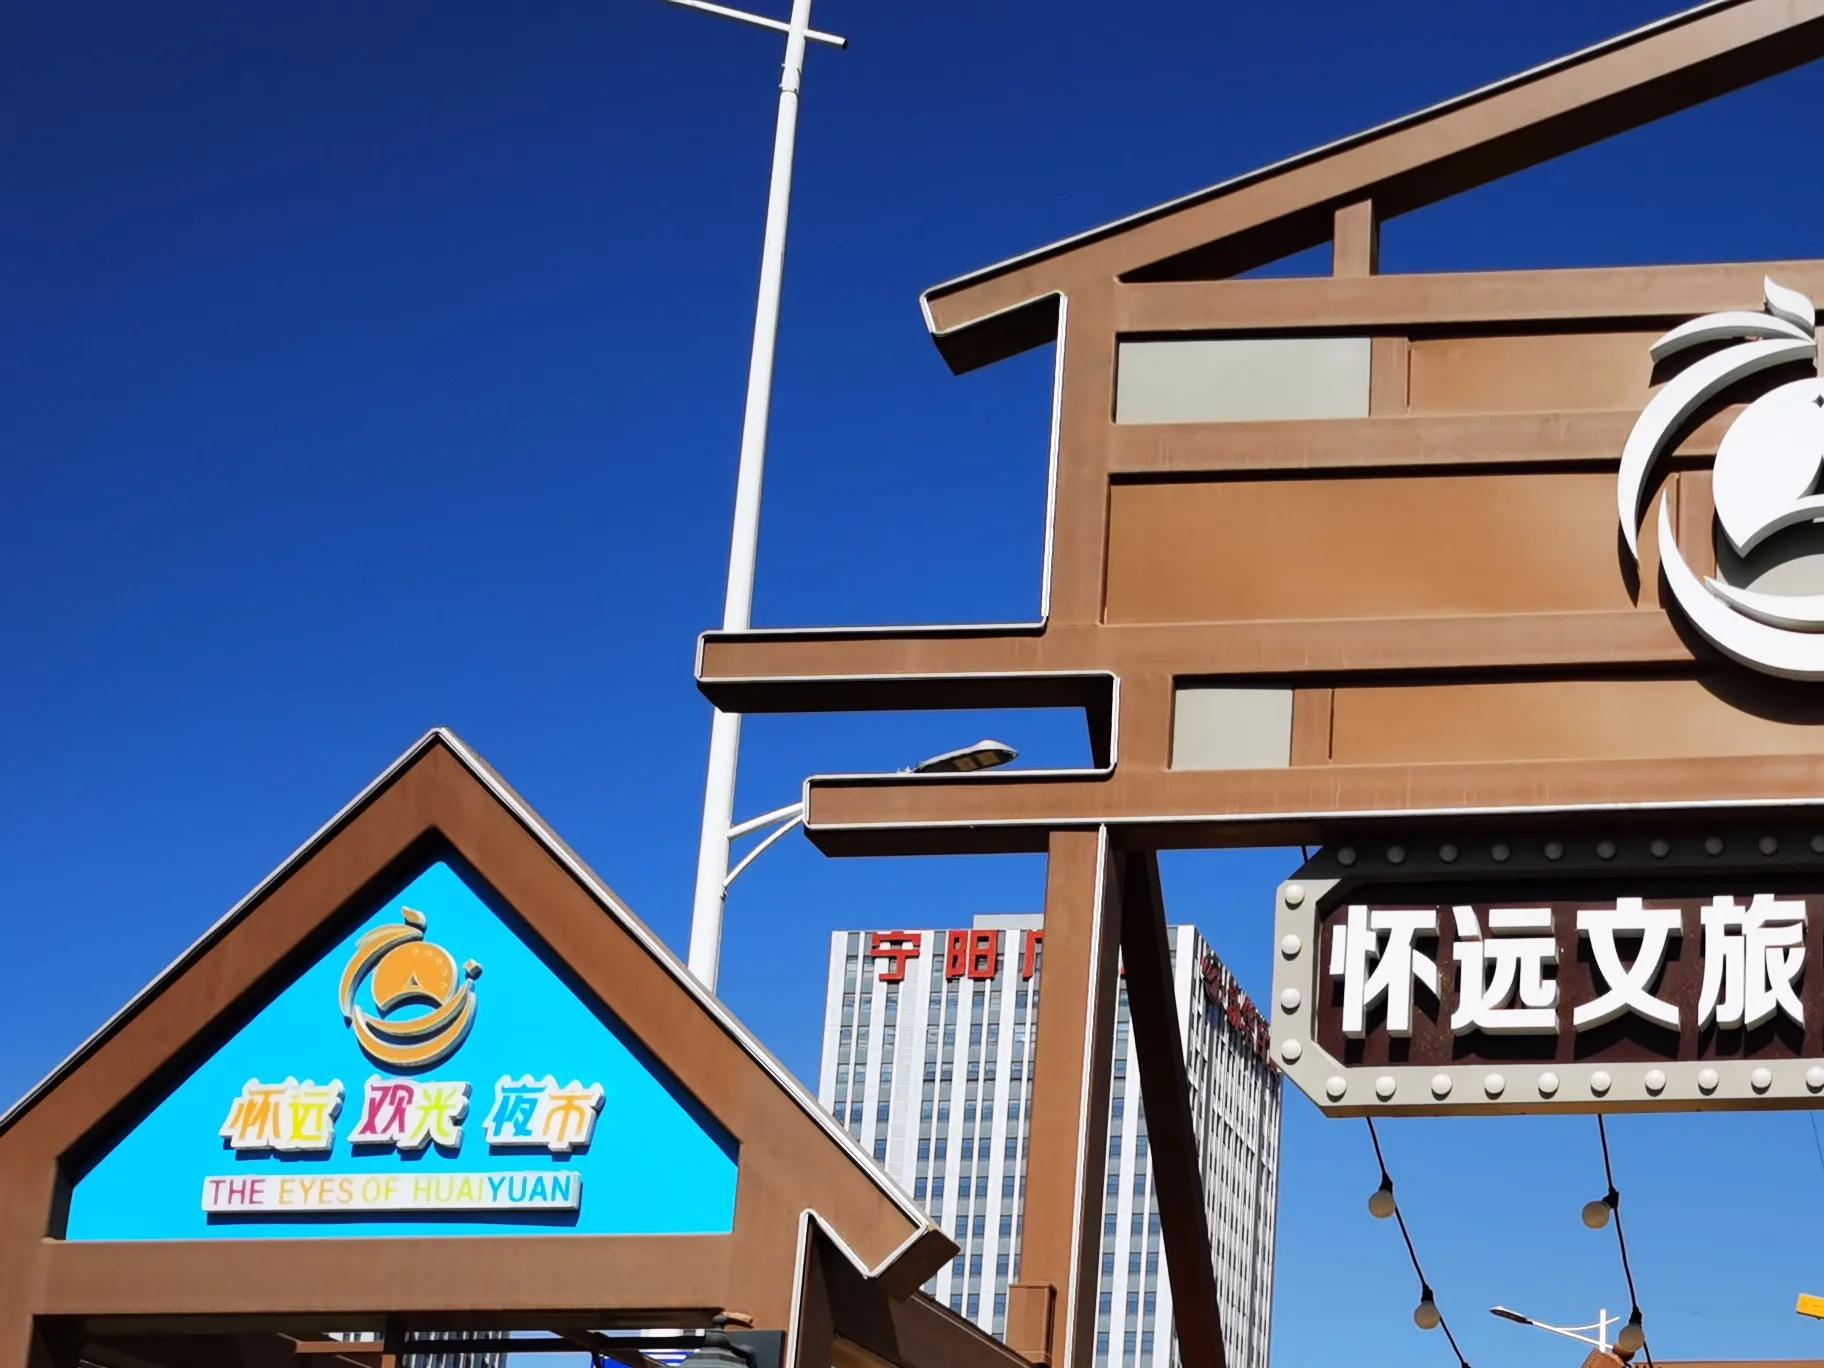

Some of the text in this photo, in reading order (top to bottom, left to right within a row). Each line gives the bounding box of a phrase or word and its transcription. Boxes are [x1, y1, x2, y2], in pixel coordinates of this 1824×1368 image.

[228, 1088, 331, 1142] 怀远
[492, 1083, 590, 1142] 夜市
[209, 1175, 571, 1205] THE EYES OF HUAIYUAN
